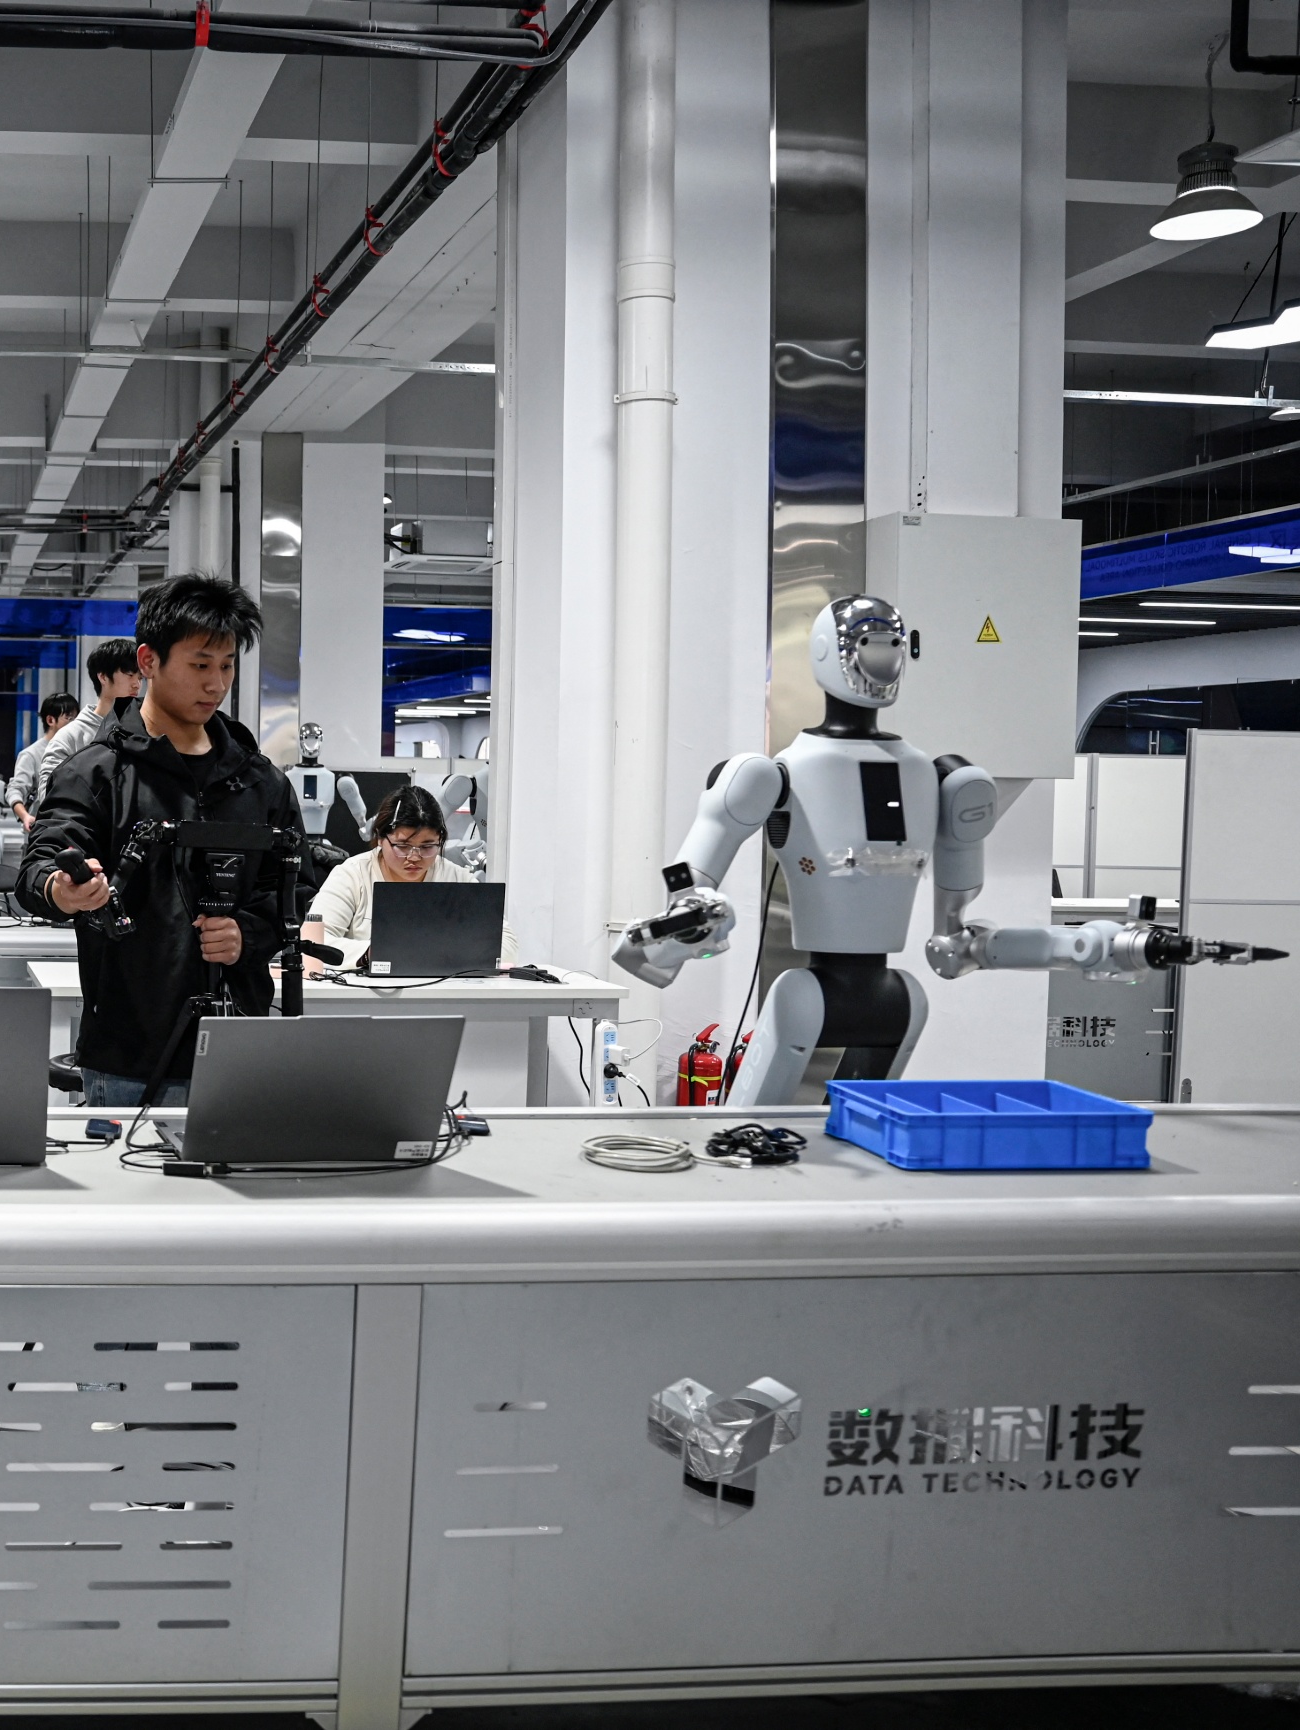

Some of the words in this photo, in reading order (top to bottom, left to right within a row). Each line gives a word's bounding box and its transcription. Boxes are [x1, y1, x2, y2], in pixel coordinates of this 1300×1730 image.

[958, 801, 994, 823] G1
[198, 1032, 207, 1054] Lenovo
[1047, 1039, 1115, 1048] ECHNOLOGY
[826, 1403, 1145, 1467] 数据科技
[824, 1473, 904, 1497] DATA
[922, 1467, 1142, 1494] TECHNOLOGY
